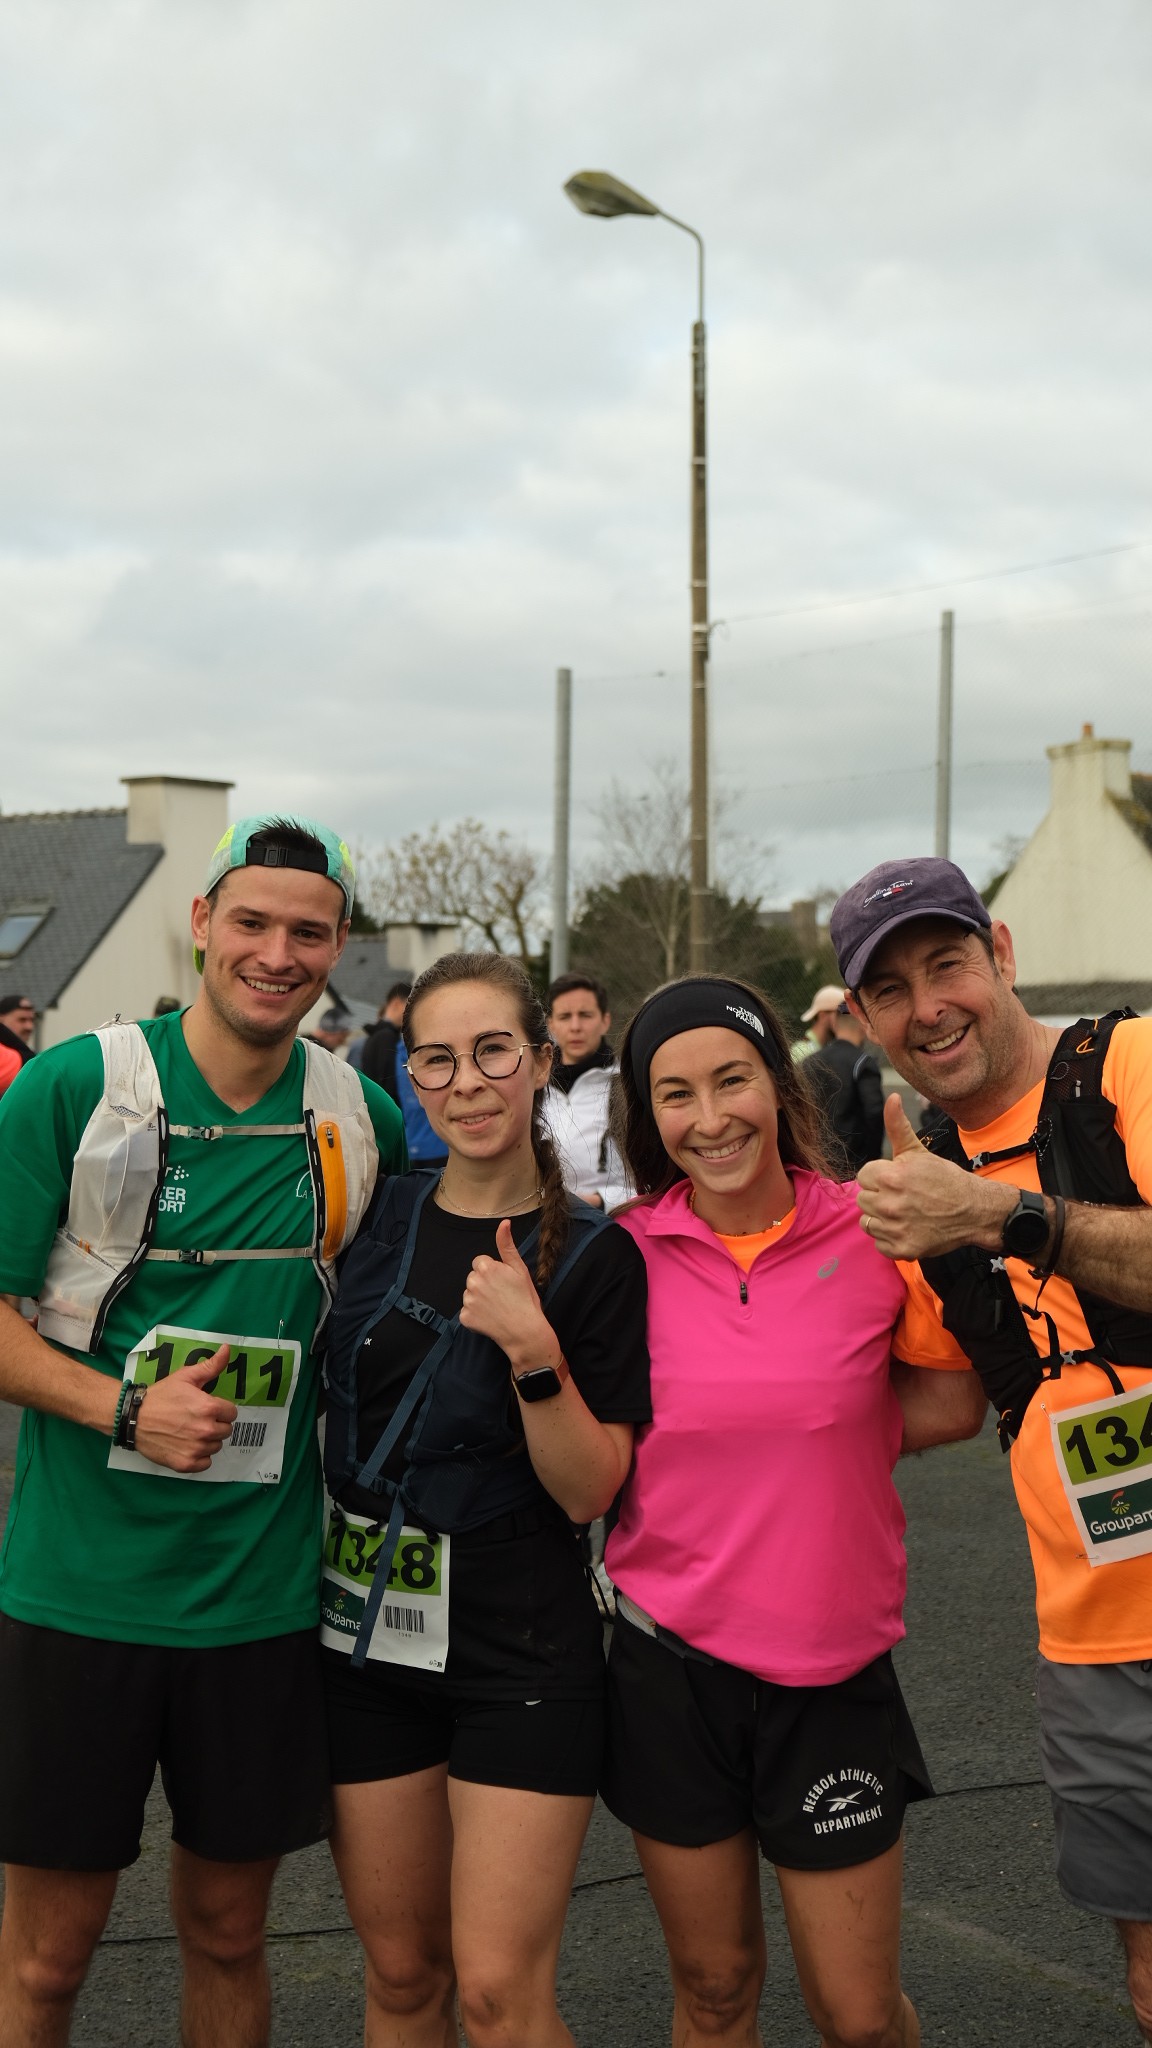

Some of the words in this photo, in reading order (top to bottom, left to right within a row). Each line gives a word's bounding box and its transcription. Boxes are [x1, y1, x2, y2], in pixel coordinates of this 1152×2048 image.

[802, 1773, 838, 1813] REEBOK
[840, 1768, 884, 1796] ATHLETIC
[813, 1805, 883, 1835] DEPARTMENT
